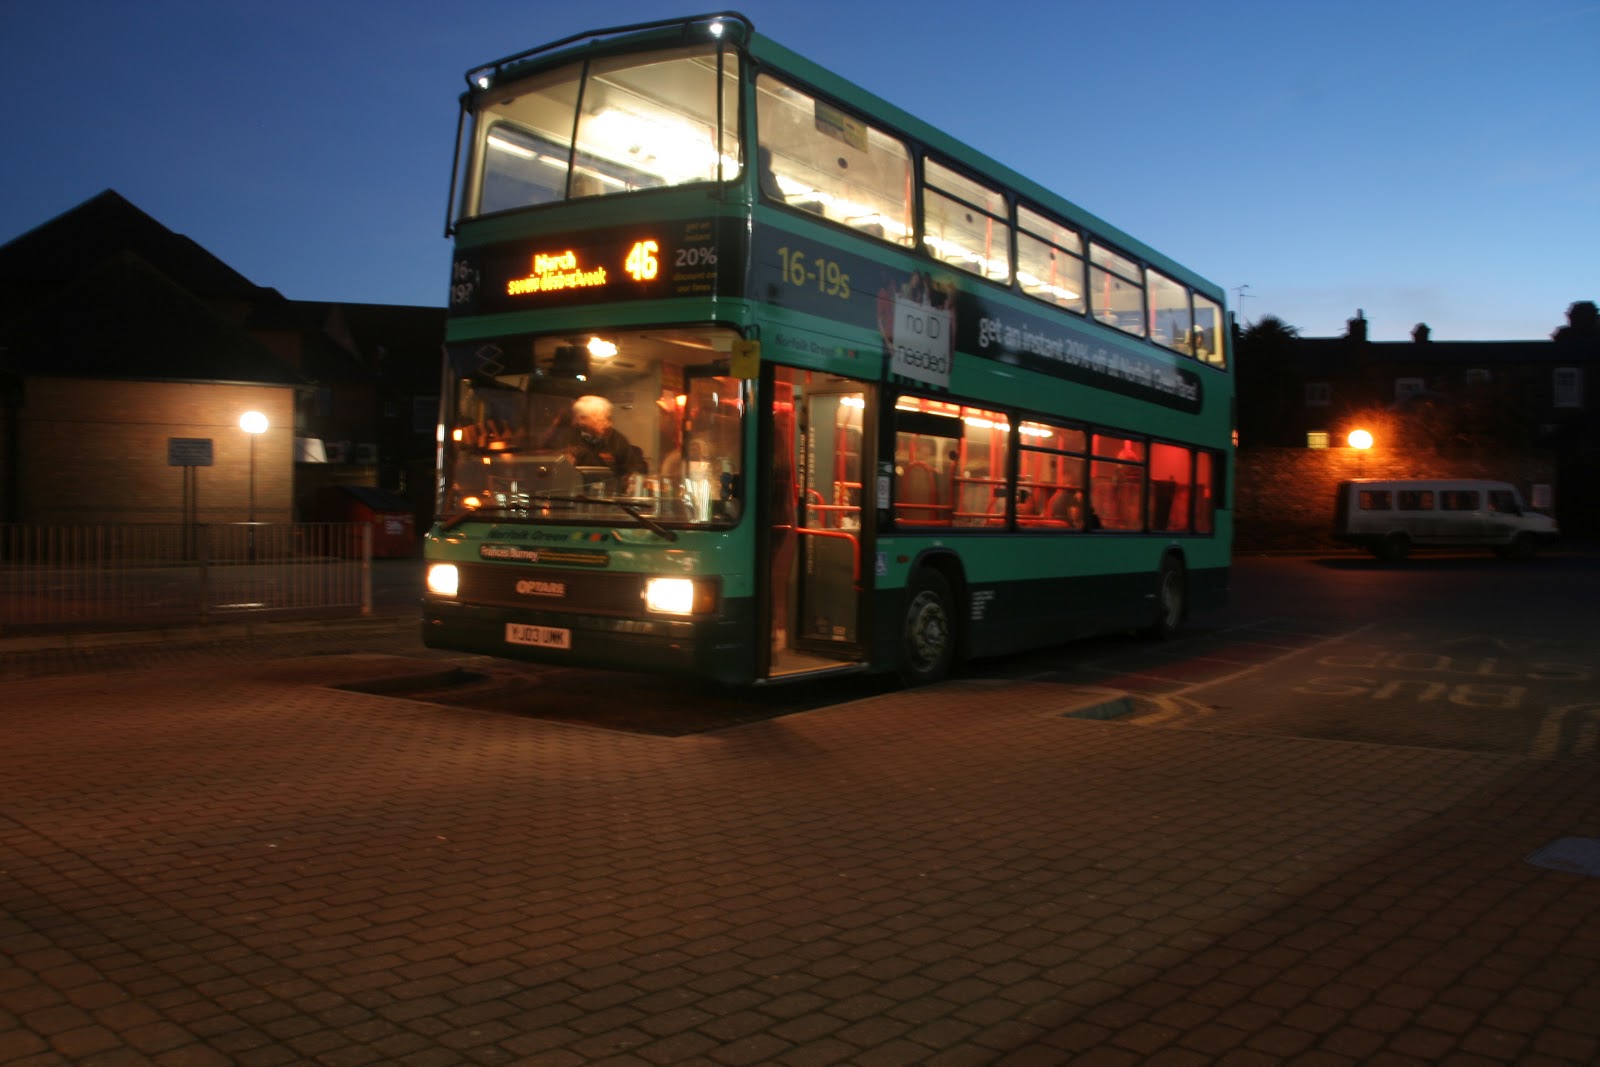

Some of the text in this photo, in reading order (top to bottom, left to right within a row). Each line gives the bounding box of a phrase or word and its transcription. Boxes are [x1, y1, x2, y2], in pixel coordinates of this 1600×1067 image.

[626, 240, 659, 281] 46
[675, 246, 718, 267] 20%
[777, 246, 851, 300] 16-19s
[906, 314, 941, 339] no ID
[980, 317, 1002, 348] get
[1004, 326, 1021, 348] an
[897, 344, 947, 375] needed
